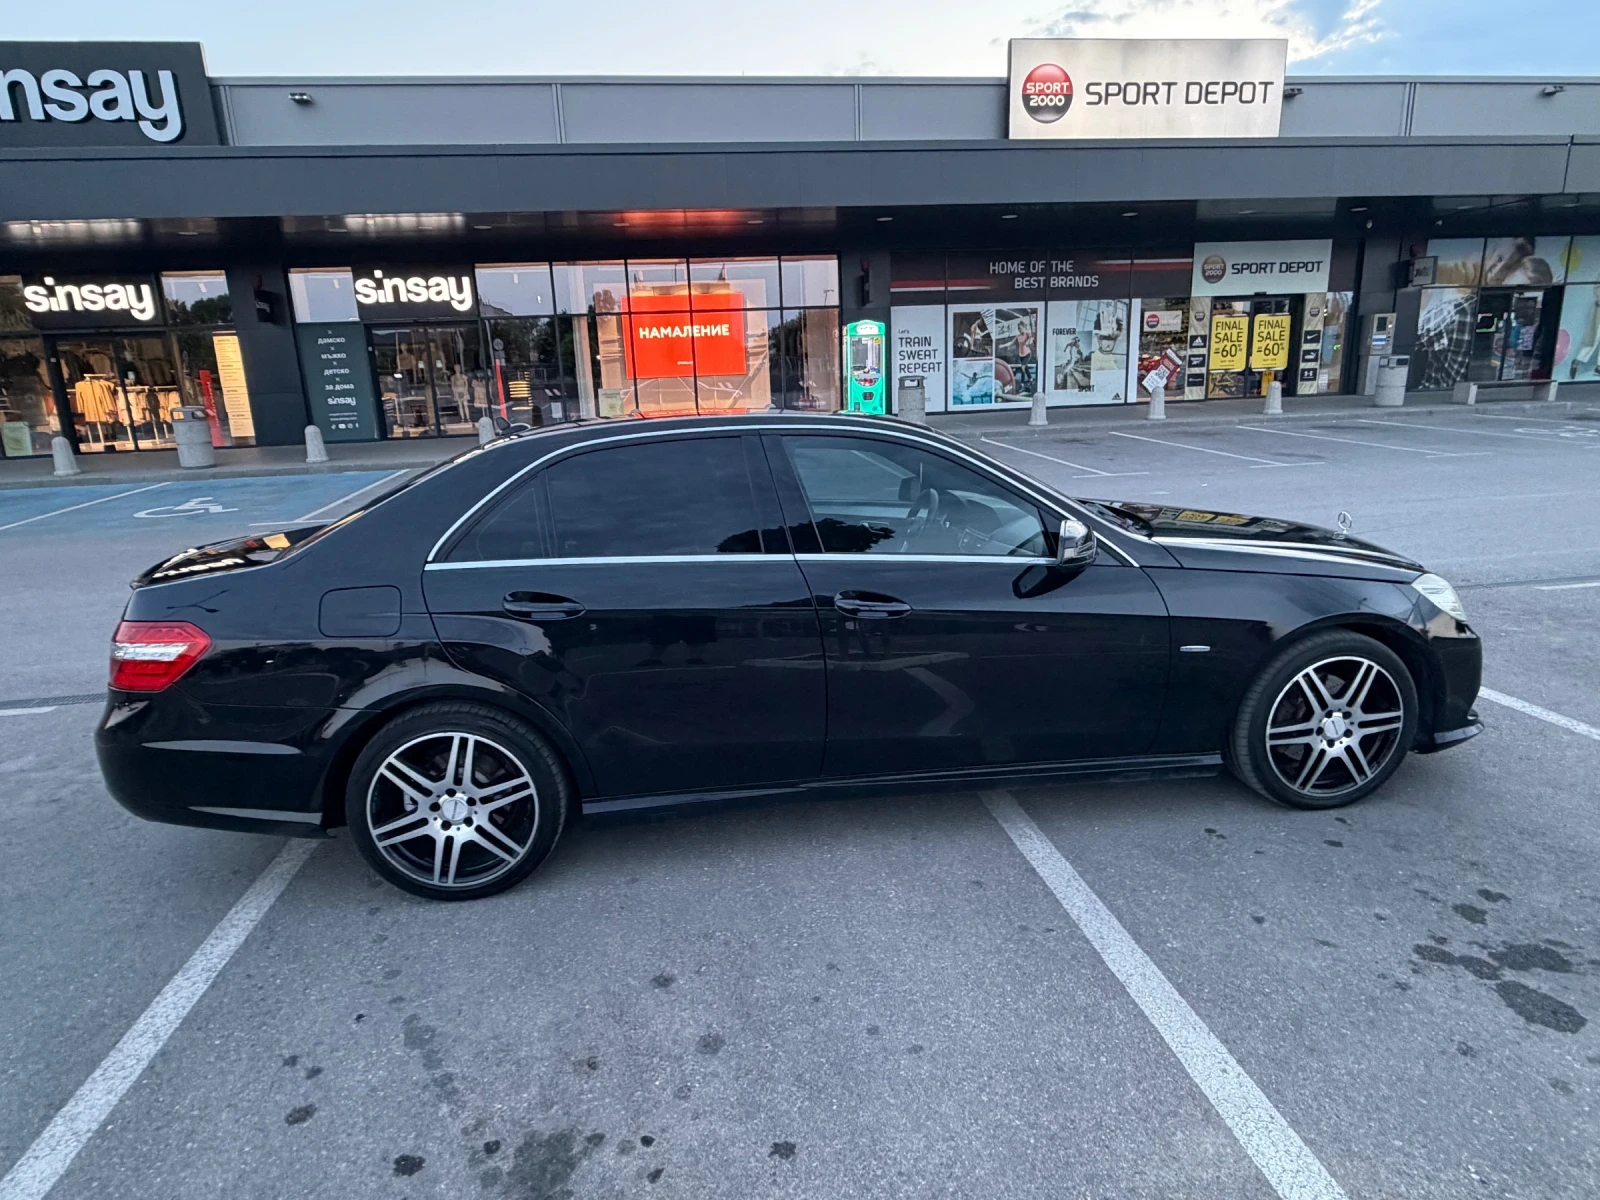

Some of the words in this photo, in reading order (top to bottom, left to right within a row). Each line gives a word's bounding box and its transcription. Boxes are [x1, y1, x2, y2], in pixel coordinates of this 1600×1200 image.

[1026, 82, 1070, 94] SPORT
[1085, 82, 1178, 105] SPORT
[1185, 81, 1275, 104] DEPOT
[1029, 95, 1065, 107] 2000
[989, 261, 1026, 275] HOME
[1029, 260, 1047, 273] OF
[1050, 260, 1074, 273] THE
[1231, 262, 1277, 275] SPORT
[1279, 260, 1323, 273] DEPOT
[1014, 276, 1046, 289] BEST
[1050, 275, 1099, 288] BRANDS
[355, 269, 473, 312] sinsay
[23, 276, 155, 321] sinsay
[639, 323, 730, 339] НАМАЛЕНИЕ
[1215, 321, 1244, 332] FINAL
[1258, 319, 1286, 331] FINAL
[1052, 327, 1077, 336] FOREVER
[1214, 331, 1244, 344] SALE
[1257, 330, 1286, 342] SALE
[898, 336, 932, 348] TRAIN
[898, 349, 939, 361] SWEAT
[898, 361, 943, 374] REPEAT
[327, 396, 357, 406] sinsay
